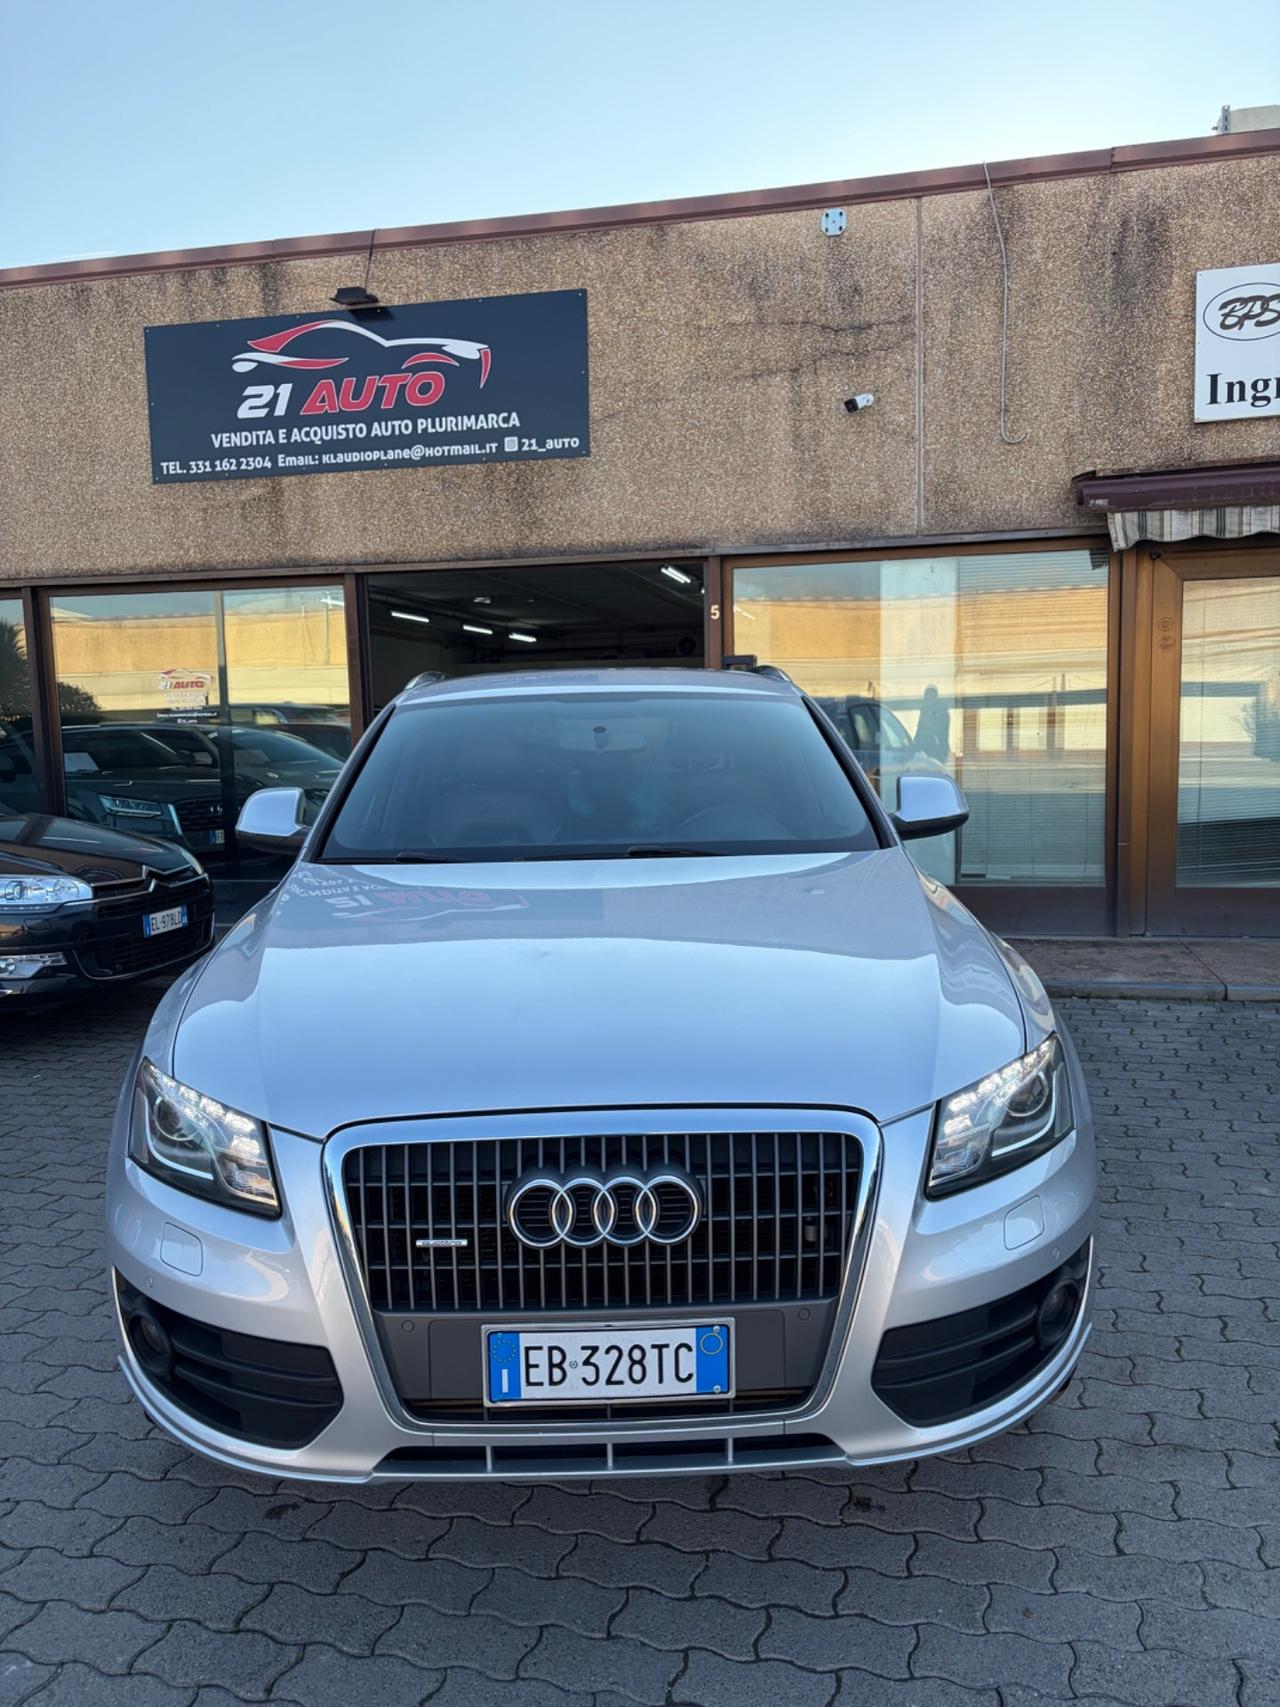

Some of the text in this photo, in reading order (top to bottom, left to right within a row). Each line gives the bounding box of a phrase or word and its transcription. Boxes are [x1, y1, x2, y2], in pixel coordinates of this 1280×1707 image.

[236, 371, 446, 419] 21 AUTO
[211, 412, 521, 448] VENDITA E ACQUISTO AUTO PLURIMARCA
[160, 461, 187, 475] TEL.
[189, 459, 212, 474] 331
[214, 458, 238, 472] 162
[239, 456, 272, 470] 2304
[710, 604, 720, 620] 5
